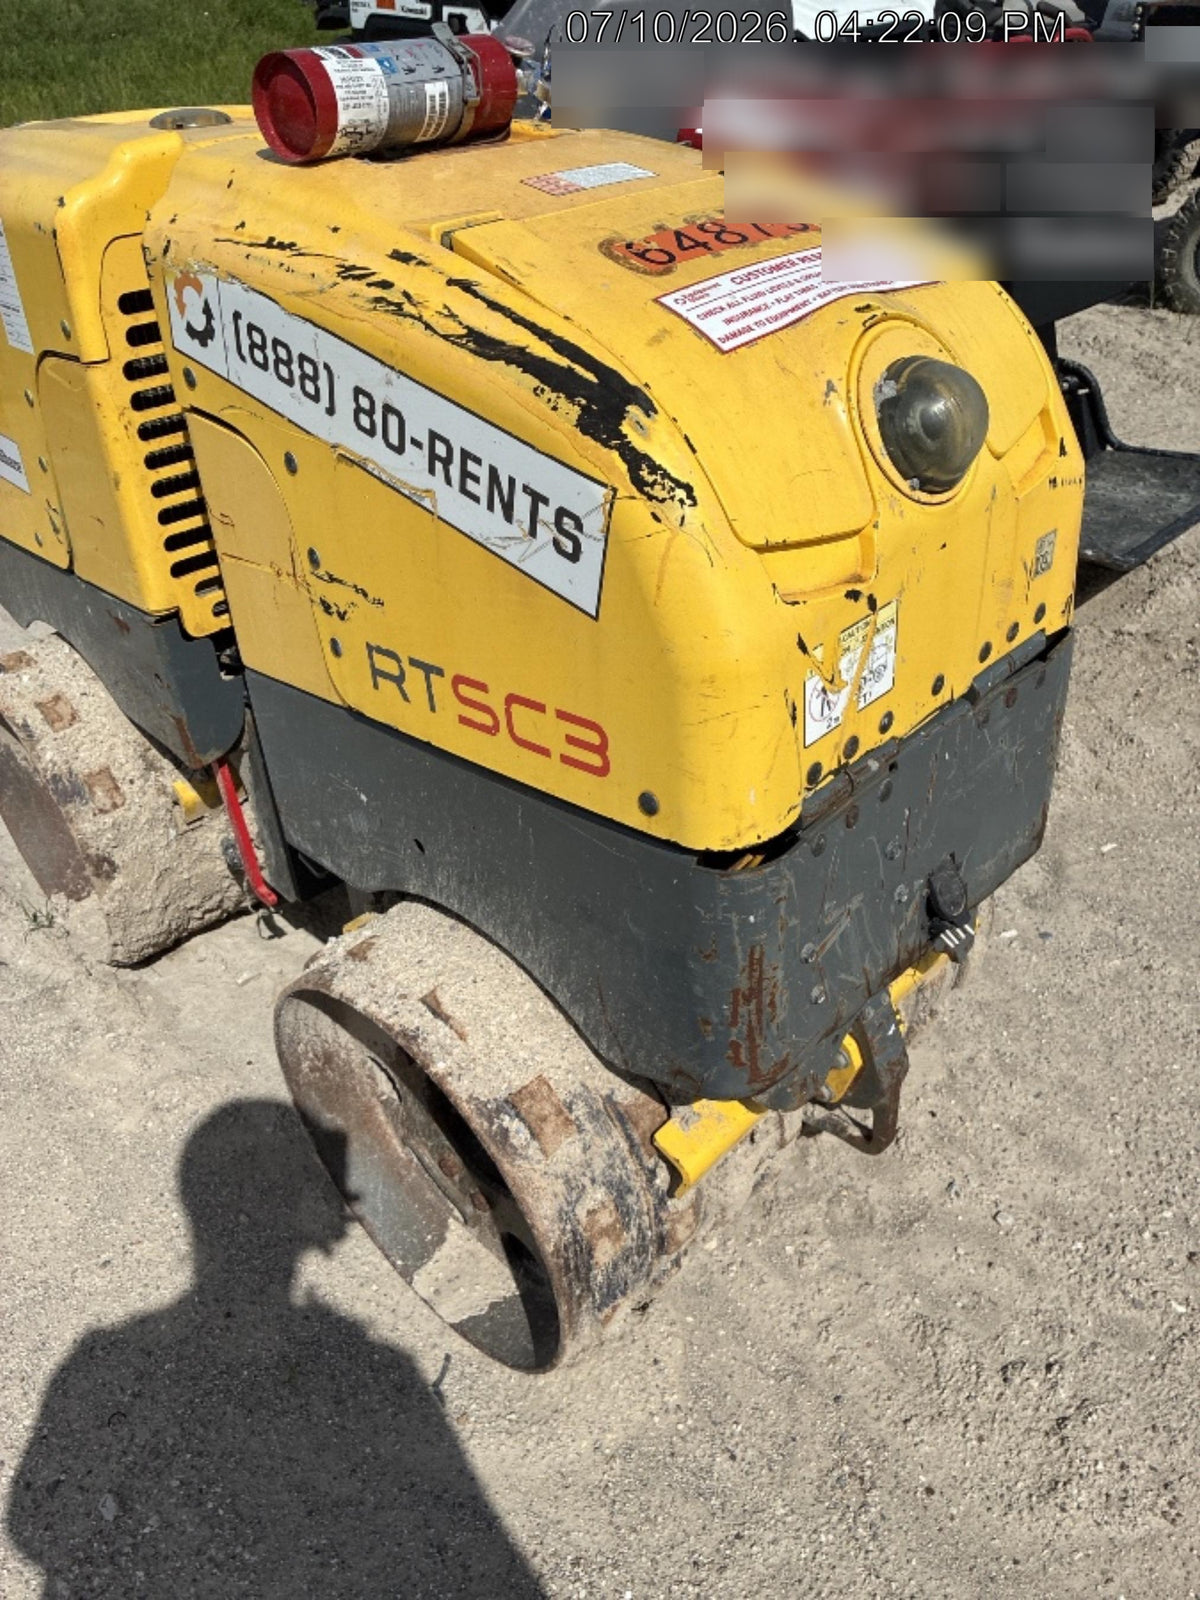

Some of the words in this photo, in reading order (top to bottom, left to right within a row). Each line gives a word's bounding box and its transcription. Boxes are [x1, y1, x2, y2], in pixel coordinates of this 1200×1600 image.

[730, 258, 797, 285] CUSTOMER
[696, 305, 727, 321] CHECK
[717, 323, 756, 344] DAMAGE
[754, 318, 767, 329] TO
[765, 296, 812, 325] EQUIPMENT
[722, 302, 773, 326] INSURANCE
[231, 309, 337, 417] (888)
[352, 384, 585, 565] 80-RENTS
